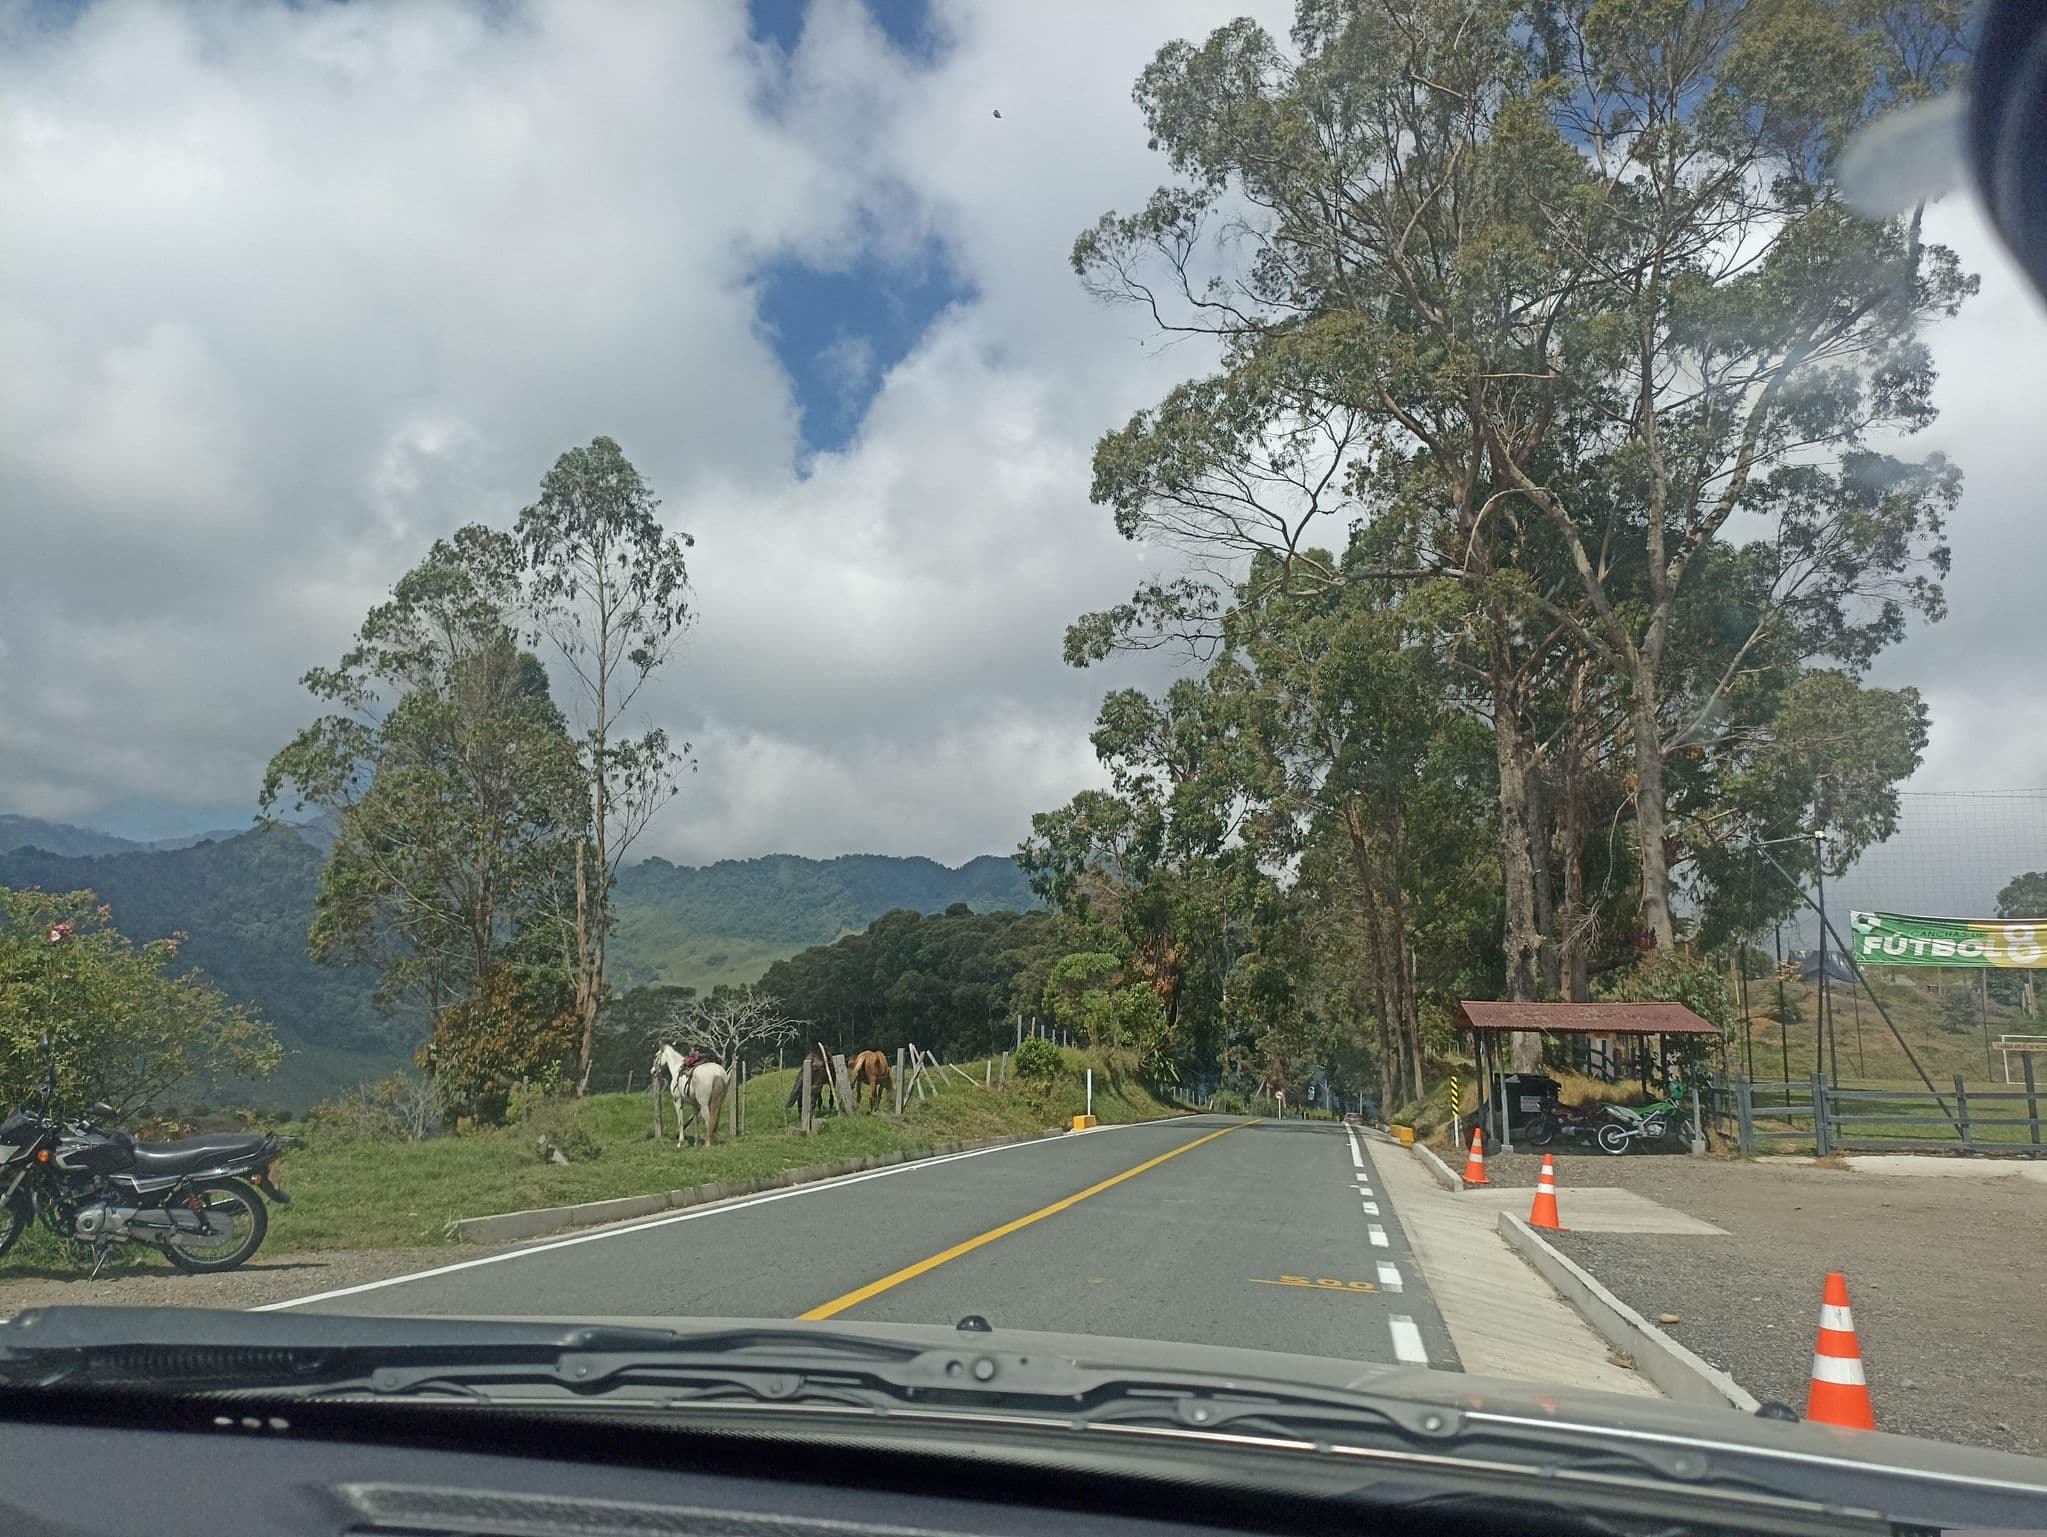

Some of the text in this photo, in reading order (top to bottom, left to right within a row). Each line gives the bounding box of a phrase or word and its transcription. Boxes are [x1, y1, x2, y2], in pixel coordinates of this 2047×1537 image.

[1863, 924, 2042, 964] FÚTBOL 8
[1911, 930, 1968, 938] CANCHAS
